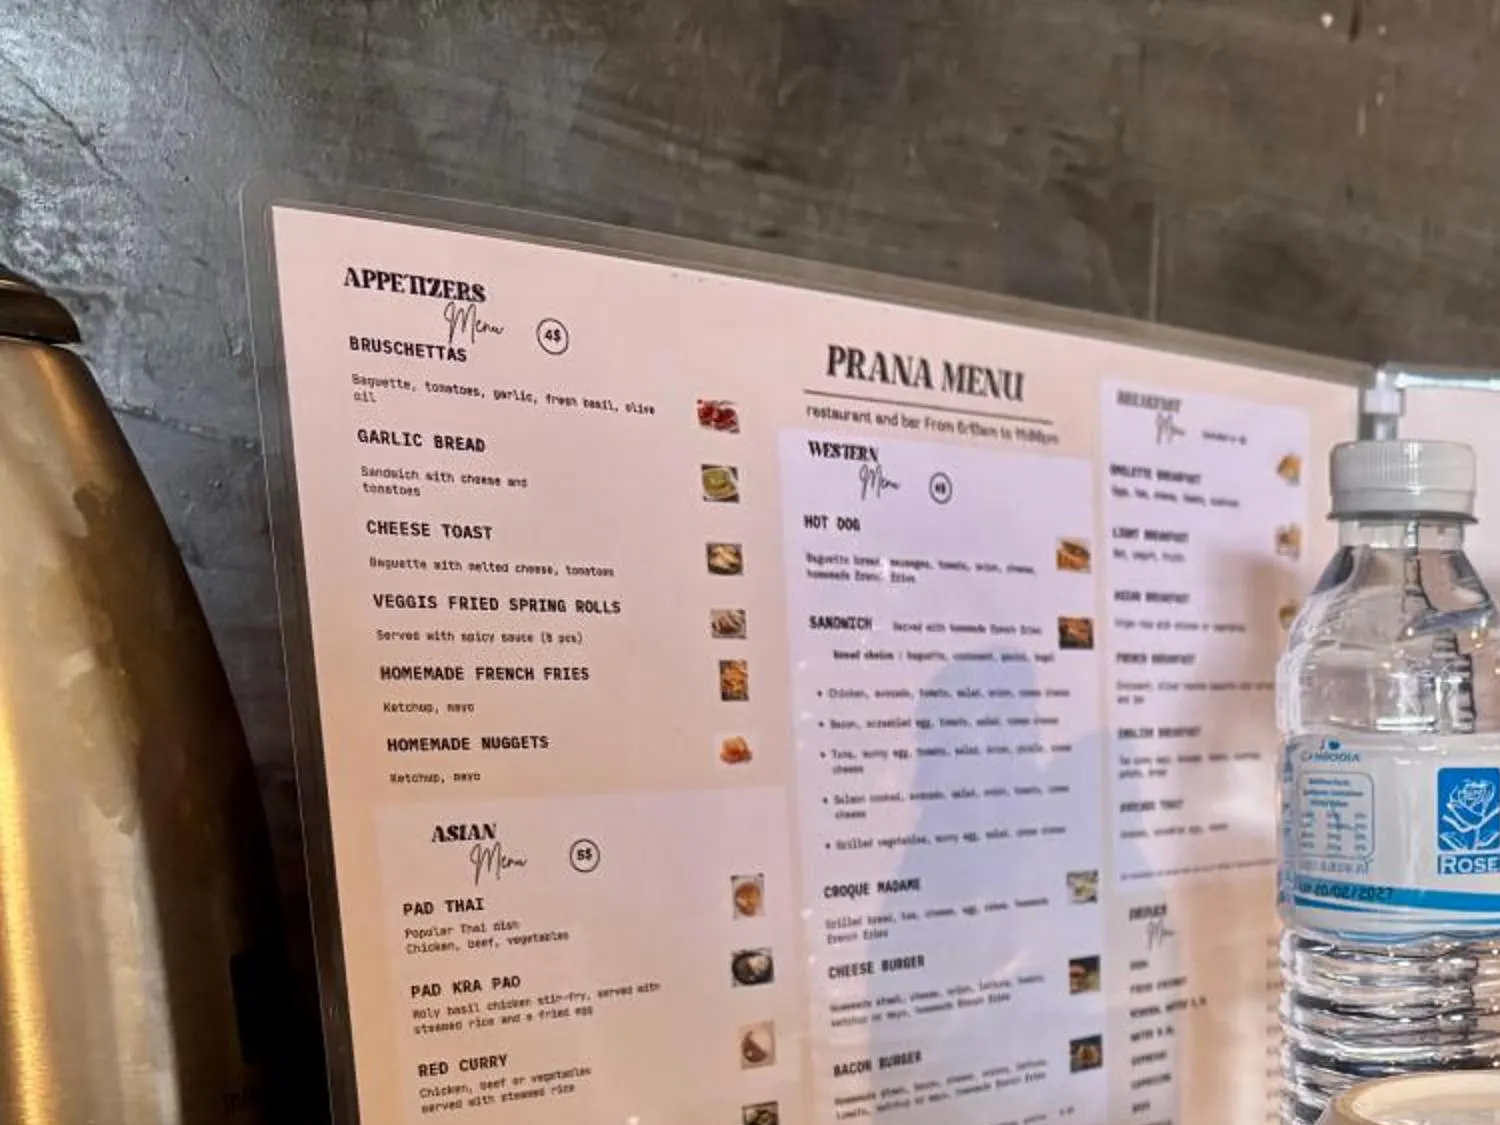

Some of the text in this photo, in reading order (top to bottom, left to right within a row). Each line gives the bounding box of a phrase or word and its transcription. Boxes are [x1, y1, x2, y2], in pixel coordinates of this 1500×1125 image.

[343, 267, 487, 303] APPETIZERS
[544, 329, 561, 342] 4$
[349, 336, 467, 362] BRUSCHETTAS
[826, 344, 1024, 402] PRANA MENU
[352, 373, 416, 391] Baguette,
[425, 380, 485, 398] tomatoes,
[493, 387, 538, 405] garlic,
[545, 393, 577, 407] fresh
[625, 402, 655, 415] olive
[807, 404, 871, 423] restaurant
[876, 413, 898, 426] and
[902, 416, 920, 429] bar
[357, 429, 486, 452] GARLIC BREAD
[808, 440, 878, 462] WESTERN
[361, 465, 528, 488] Sandwich with cheese and
[363, 483, 421, 497] tomatoes
[366, 520, 493, 540] CHEESE TOAST
[804, 515, 861, 531] HOT DOG
[369, 557, 614, 577] Baguette with melted cheese, tomatoes
[373, 594, 621, 614] VEGGIS FRIED SPRING ROLLS
[809, 615, 872, 630] SANDWICH
[427, 629, 454, 642] with
[461, 631, 494, 644] spicy
[501, 632, 534, 643] sauce
[380, 666, 589, 681] HOMEMADE FRENCH FRIES
[383, 702, 474, 715] Ketchup, mayo
[387, 735, 549, 752] HOMEMADE NUGGETS
[390, 771, 480, 785] Ketchup, mayo
[432, 823, 496, 843] ASIAN
[1441, 856, 1500, 874] ROSE
[824, 877, 921, 899] CROQUE MADAME
[403, 898, 484, 915] PAD THAI
[405, 925, 454, 940] Popular
[460, 921, 486, 934] Thai
[406, 931, 569, 954] Chicken, beef, vegetables
[829, 955, 925, 979] CHEESE BURGER
[411, 983, 441, 998] PAD
[453, 979, 482, 994] KRA
[413, 981, 661, 1021] Holy basil chicken stir-fry, served with
[414, 1019, 462, 1035] steamed
[469, 1016, 494, 1030] rice
[501, 1013, 520, 1025] and
[539, 1007, 570, 1020] fried
[575, 1006, 593, 1018] egg
[418, 1054, 508, 1077] RED CURRY
[833, 1050, 922, 1077] BACON BURGER
[419, 1067, 591, 1099] Chicken, beef or vegetables
[421, 1083, 574, 1114] served with steamed rice
